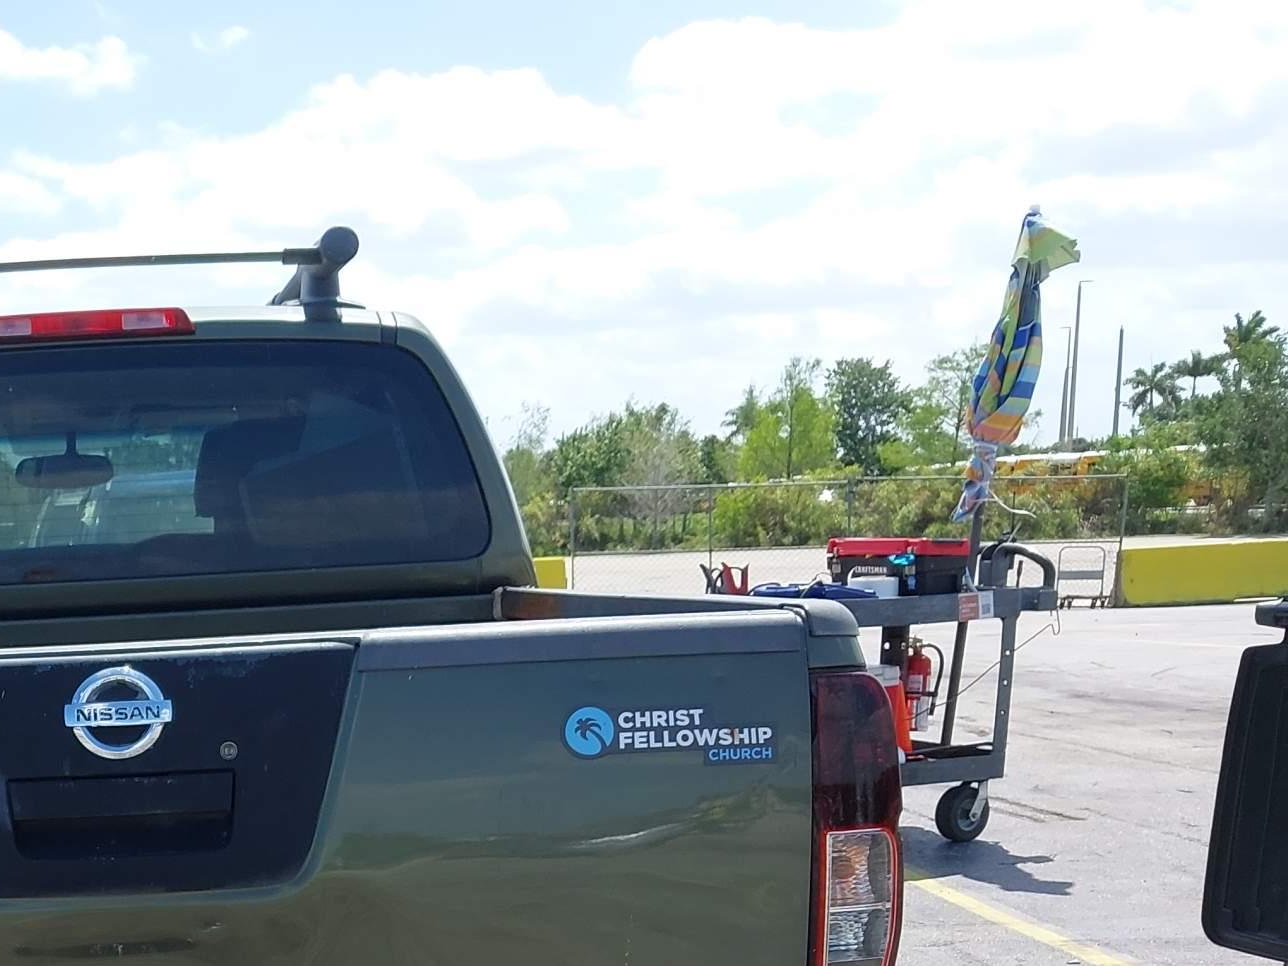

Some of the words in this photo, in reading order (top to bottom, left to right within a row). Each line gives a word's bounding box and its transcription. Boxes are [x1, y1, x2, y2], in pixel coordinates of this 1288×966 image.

[76, 705, 160, 722] NISSAN
[618, 708, 703, 729] CHRIST
[618, 727, 773, 750] FELLOWSHIP
[708, 747, 772, 761] CHURCH
